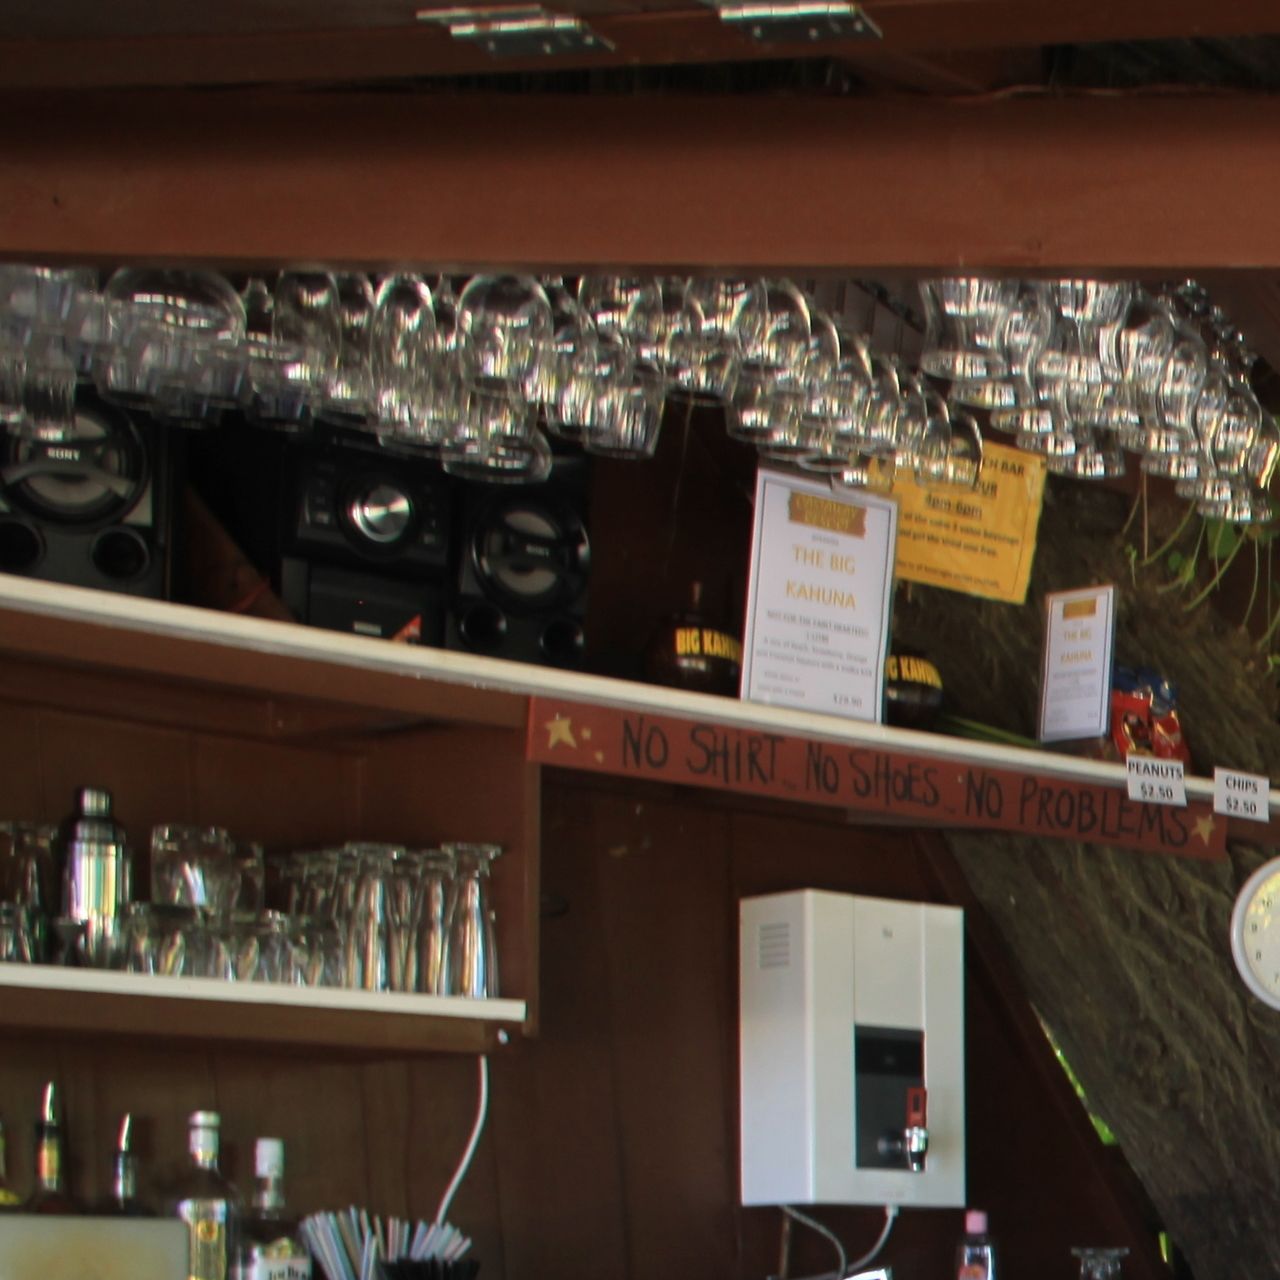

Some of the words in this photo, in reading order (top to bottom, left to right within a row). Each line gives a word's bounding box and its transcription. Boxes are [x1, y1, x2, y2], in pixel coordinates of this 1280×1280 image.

[792, 544, 823, 569] THE
[830, 552, 856, 576] BIG
[785, 579, 857, 611] KAHUNA
[676, 627, 700, 655] BIG
[622, 714, 669, 770] NO
[965, 769, 1003, 819] NO
[1018, 776, 1189, 847] PROBLEMS
[1128, 761, 1183, 781] PEANUTS
[1140, 781, 1174, 800] $2.50
[1225, 775, 1259, 794] CHIPS
[1226, 795, 1257, 815] $2.50
